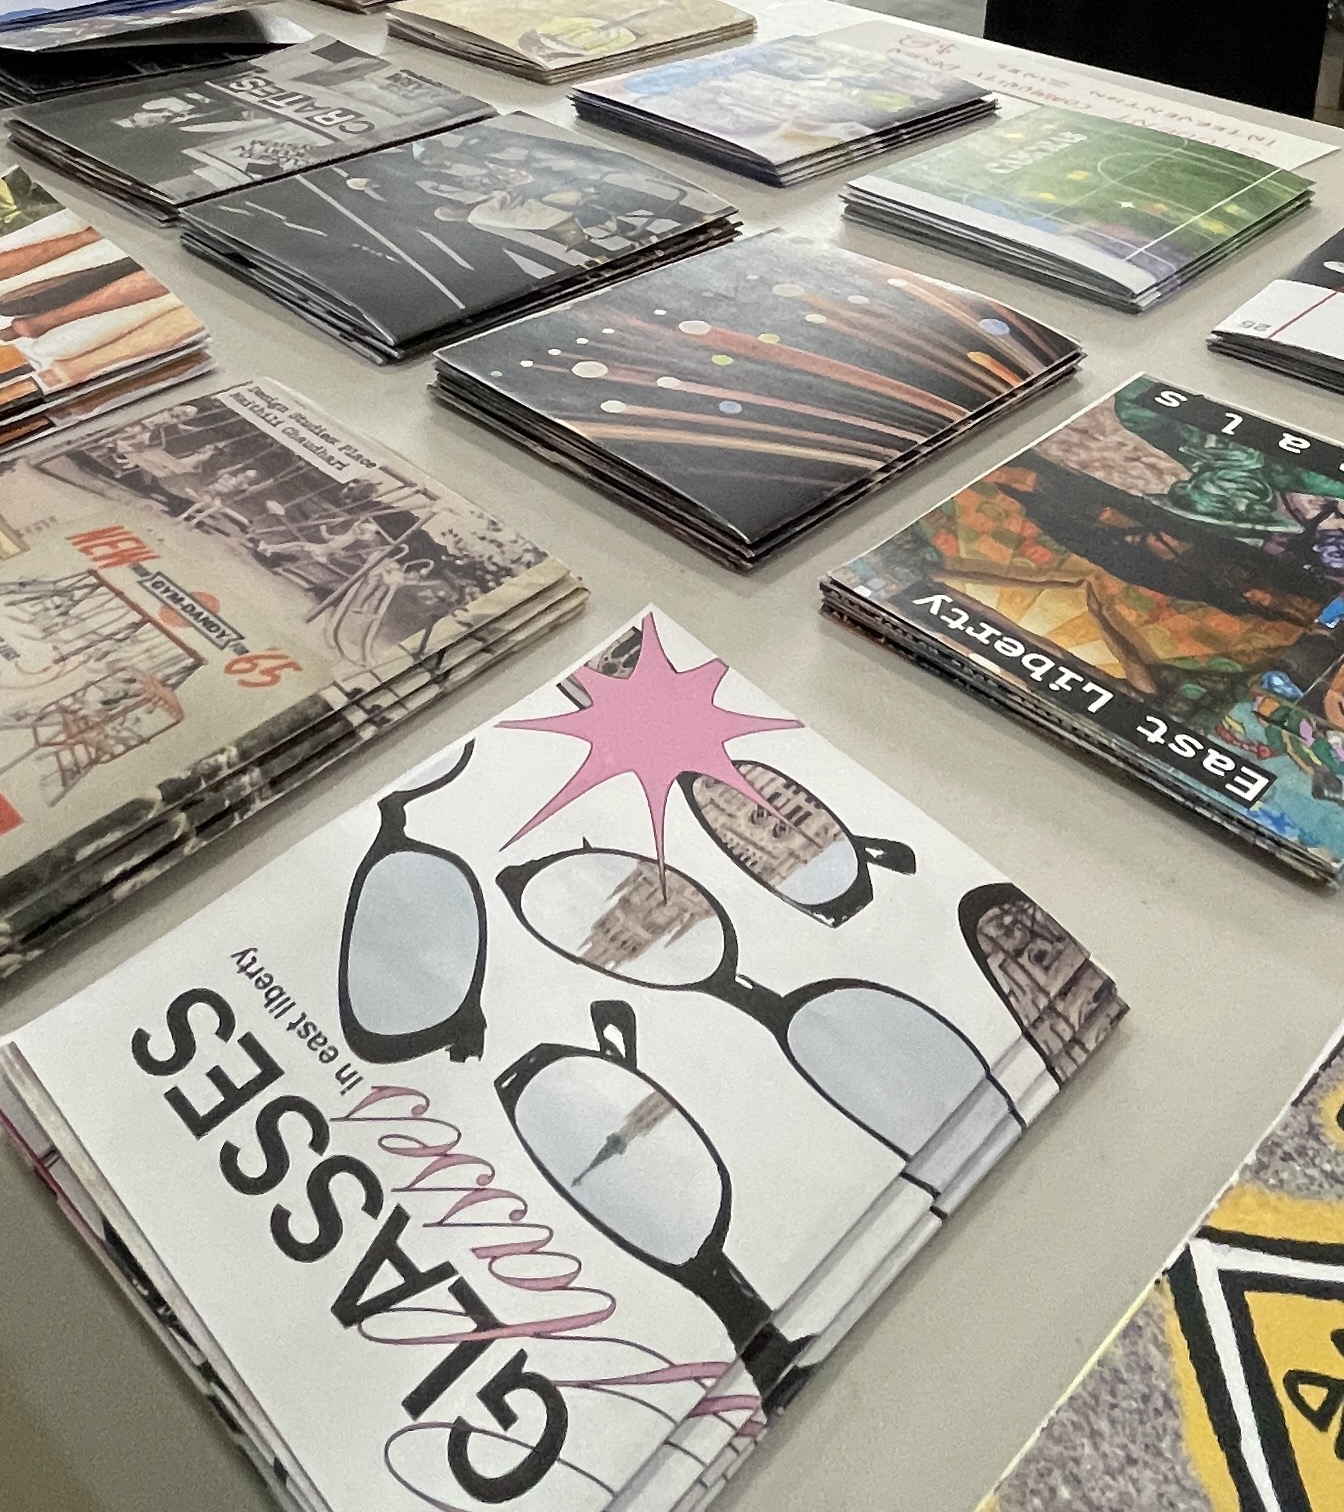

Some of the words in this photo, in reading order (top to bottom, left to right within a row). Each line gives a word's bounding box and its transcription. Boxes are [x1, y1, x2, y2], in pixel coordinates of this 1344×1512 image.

[227, 75, 377, 135] CRATES
[248, 386, 289, 414] Design
[337, 444, 377, 470] Place
[64, 525, 161, 571] NEW
[151, 579, 233, 641] GYM-DANDY
[912, 591, 1117, 715] Liberty
[1137, 713, 1271, 803] East
[231, 946, 299, 1019] liberty
[292, 1019, 344, 1080] east
[336, 1062, 363, 1096] in
[131, 987, 568, 1502] GLASSES
